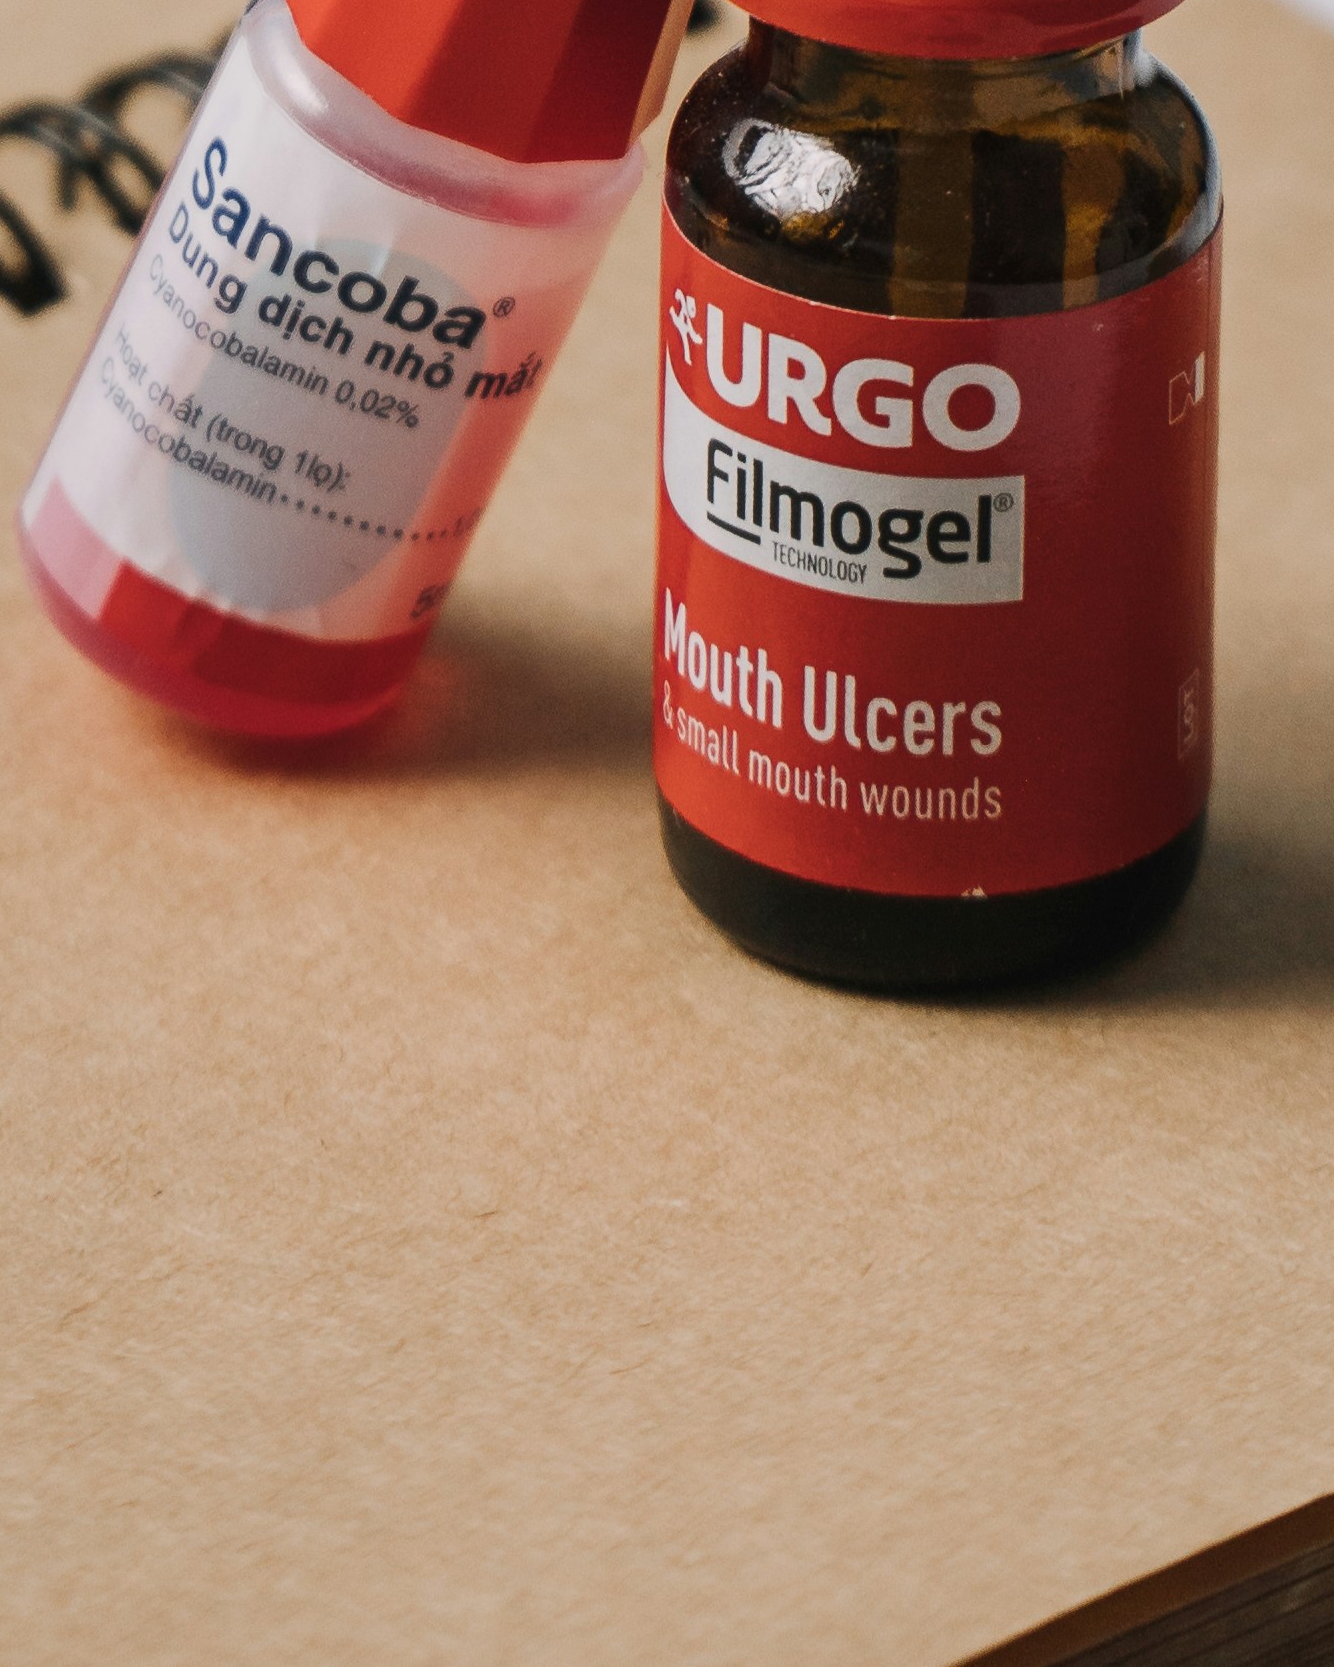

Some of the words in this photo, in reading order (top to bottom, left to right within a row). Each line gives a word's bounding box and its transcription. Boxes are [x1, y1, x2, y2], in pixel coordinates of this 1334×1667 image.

[149, 253, 329, 396] Cyanocobalamin
[334, 379, 420, 429] 0,02%
[169, 199, 249, 315] Dung
[258, 293, 354, 356] dịch
[364, 340, 455, 390] nhỏ
[205, 413, 286, 472] (trong
[705, 301, 1022, 453] URGO
[771, 539, 868, 585] TECHNOLOGY
[663, 585, 784, 730] Mouth
[803, 664, 1003, 757] Ulcers
[662, 679, 674, 730] &
[677, 706, 740, 776] small
[748, 748, 848, 812] mouth
[859, 776, 1004, 822] wounds
